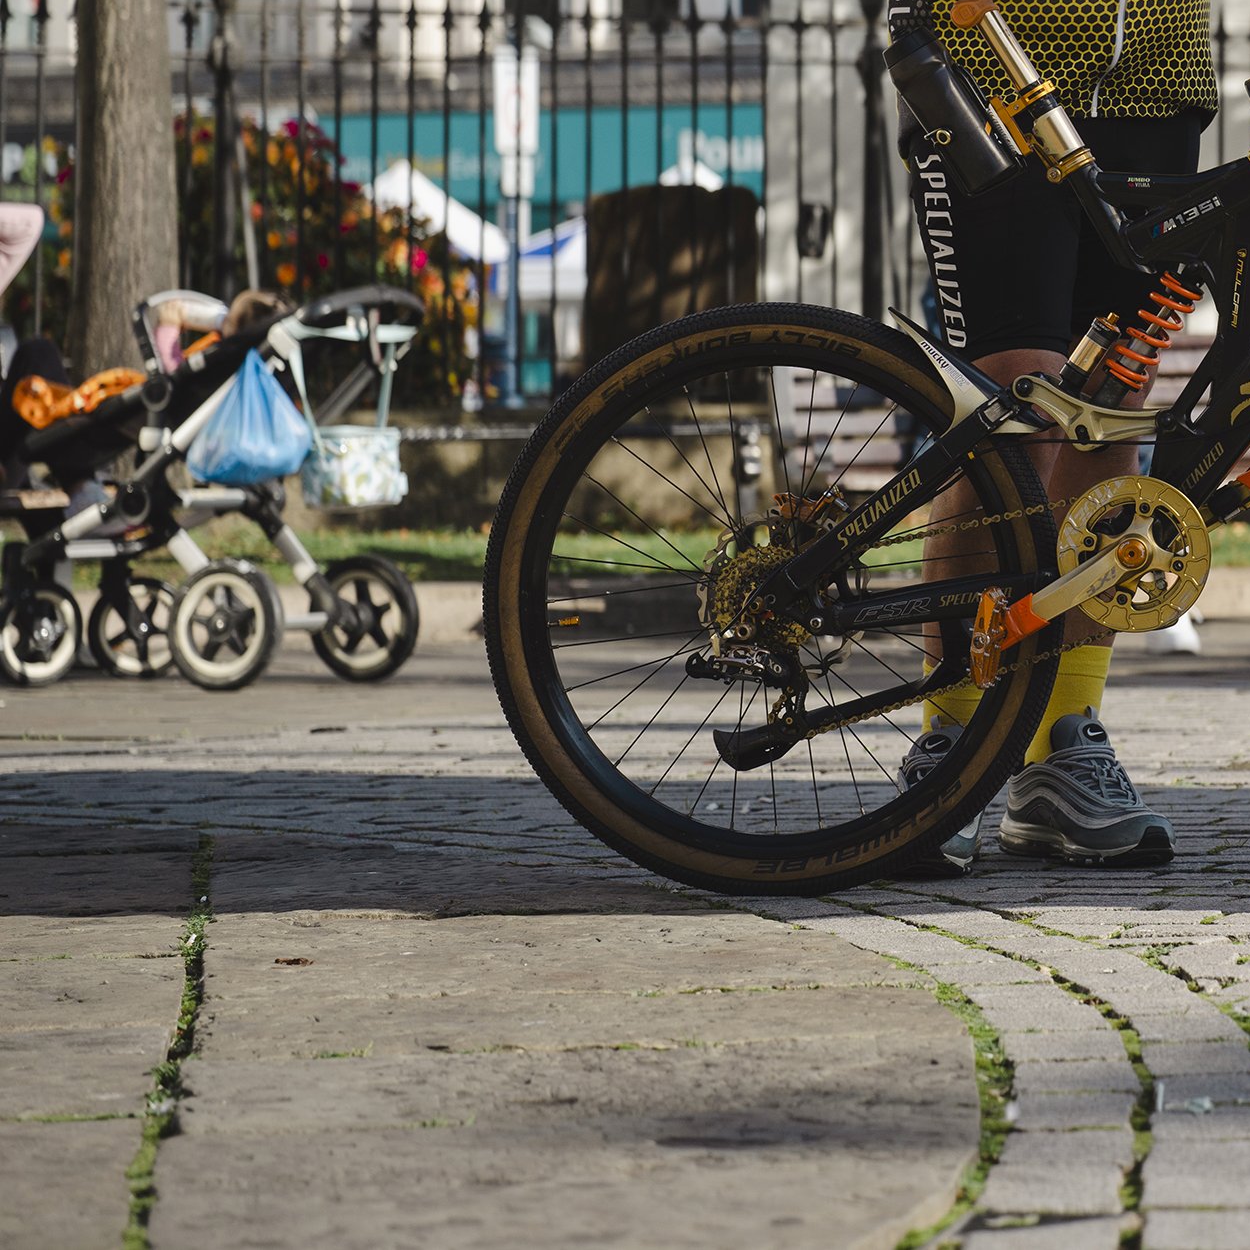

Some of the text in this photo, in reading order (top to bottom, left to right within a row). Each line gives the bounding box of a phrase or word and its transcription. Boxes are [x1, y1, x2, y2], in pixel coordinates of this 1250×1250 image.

[1162, 196, 1221, 234] M135i
[914, 154, 967, 349] SPECIALIZED
[836, 468, 922, 550] SPECIALIZED
[853, 597, 932, 623] FSR
